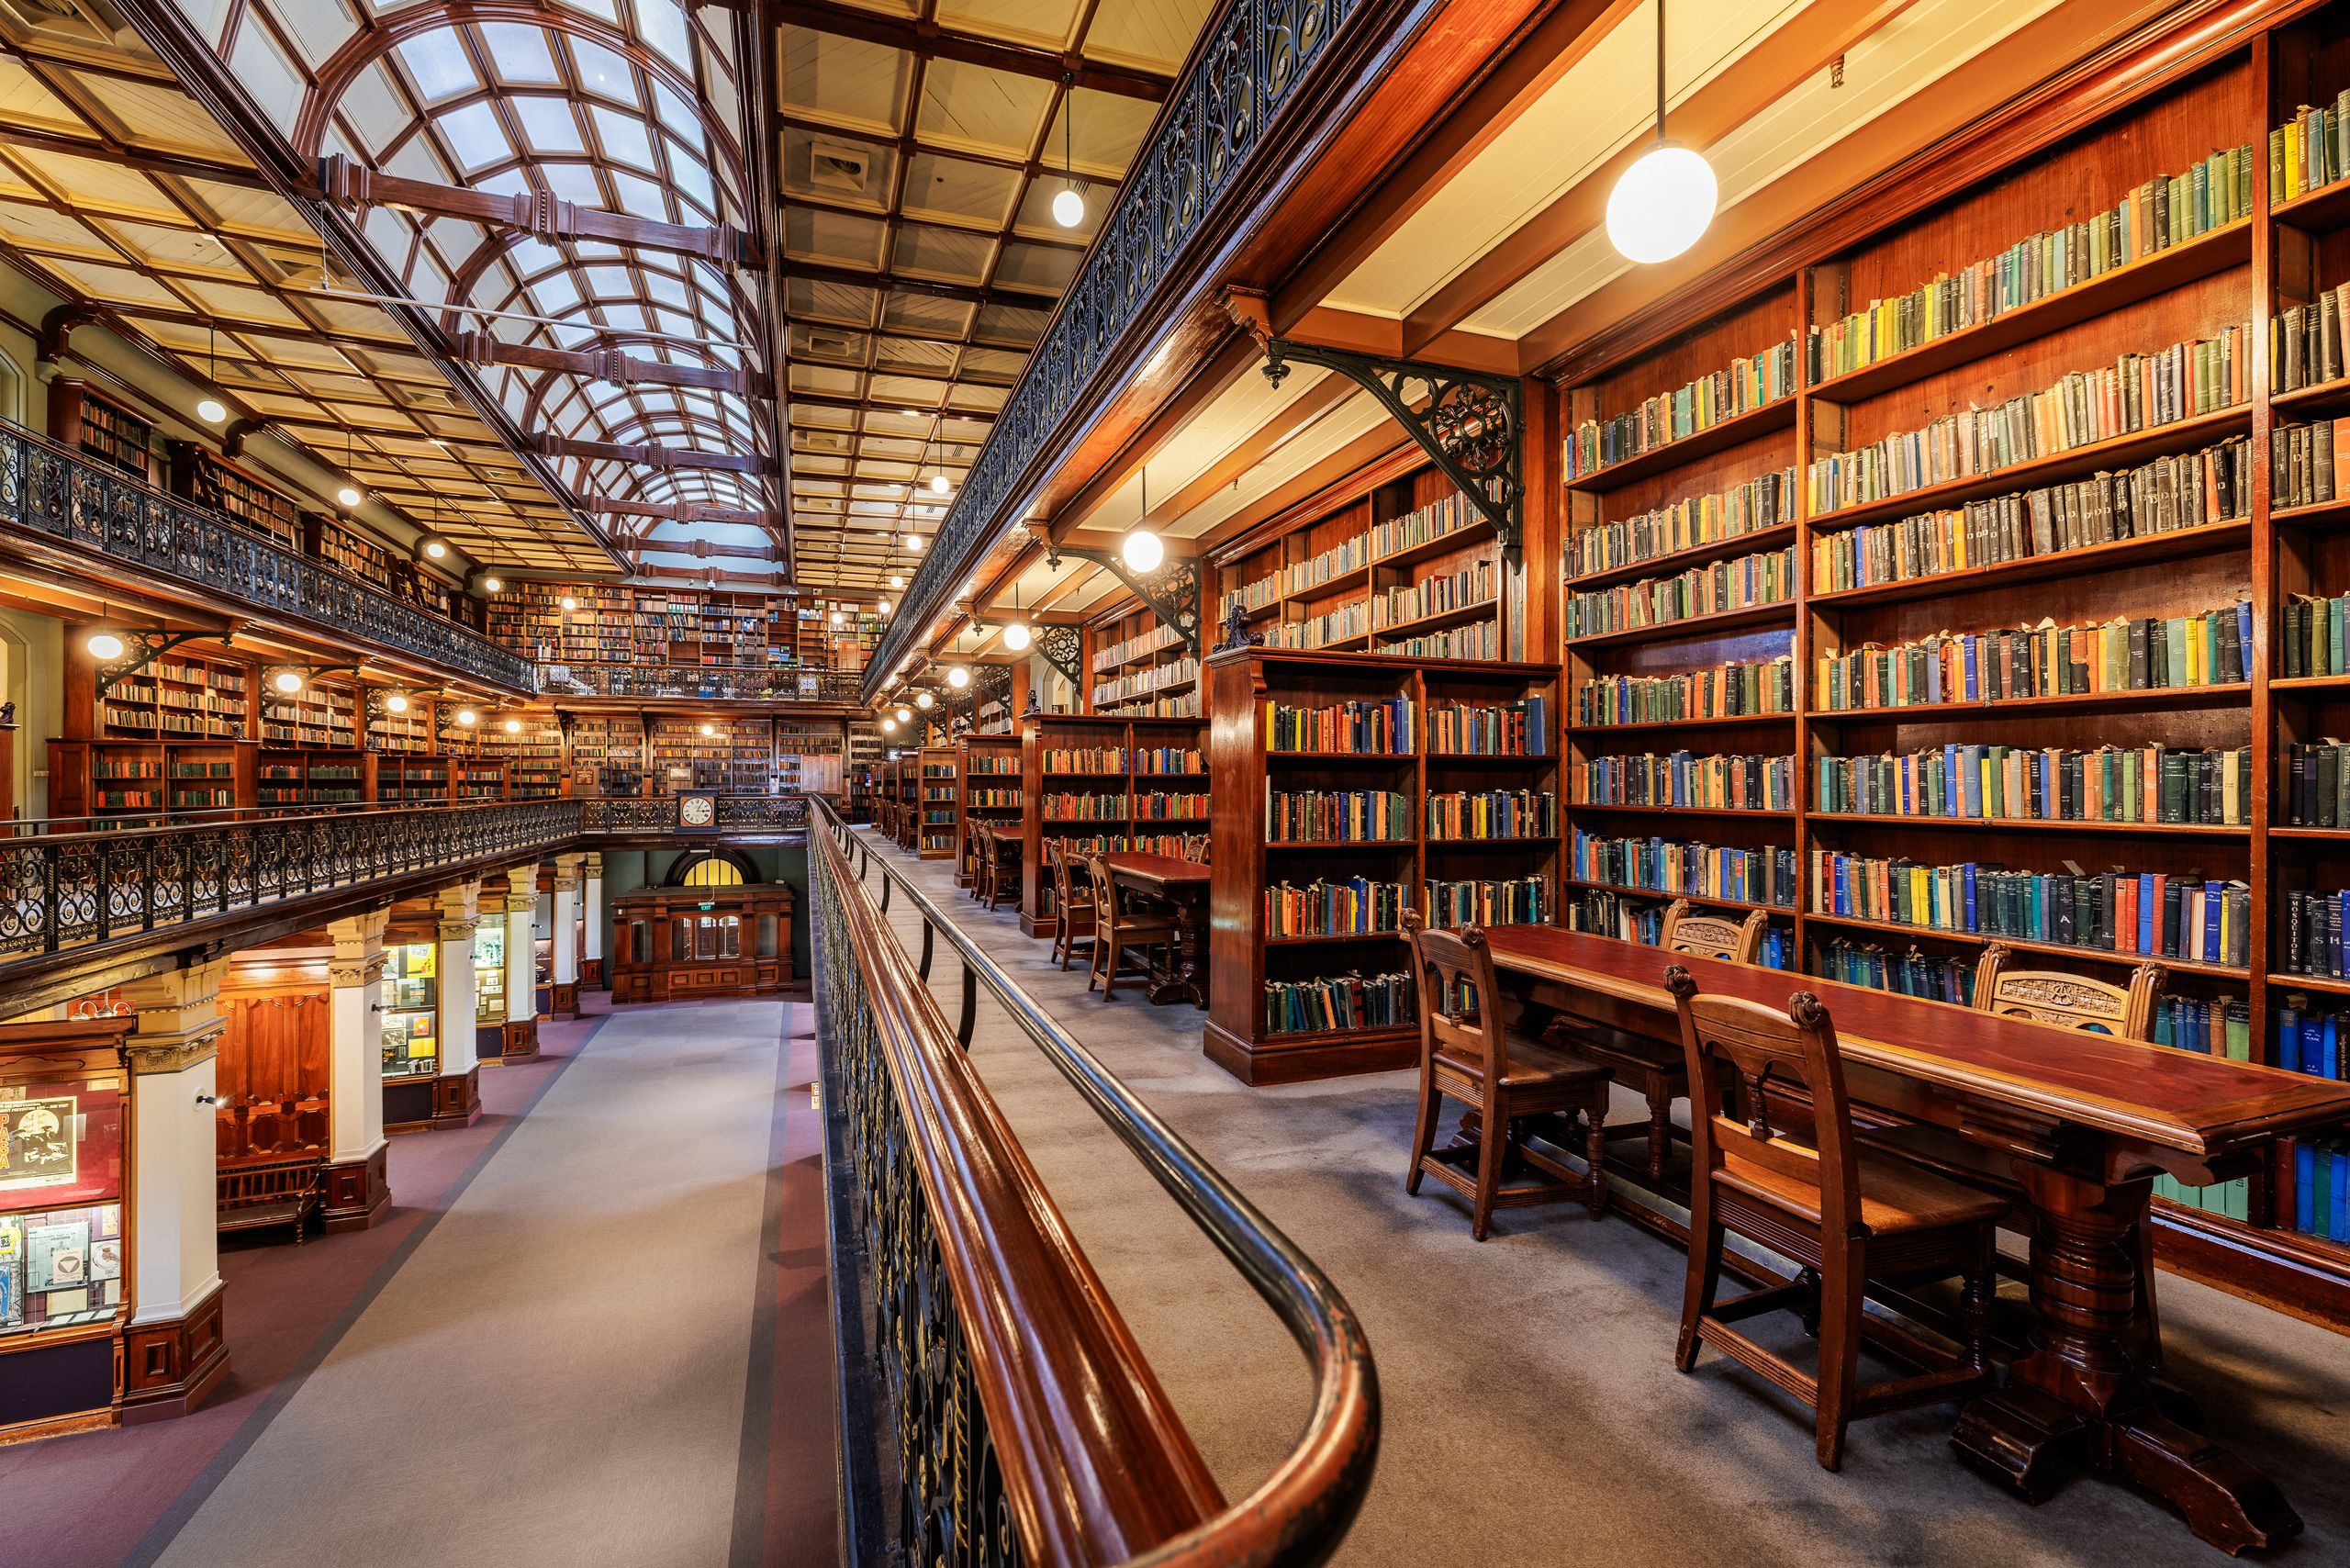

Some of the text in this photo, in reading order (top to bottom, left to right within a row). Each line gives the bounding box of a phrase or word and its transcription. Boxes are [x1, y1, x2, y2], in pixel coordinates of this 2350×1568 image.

[1957, 785, 1964, 793] S
[2060, 914, 2071, 924] A
[2290, 901, 2299, 961] MOSQUITOES
[2314, 936, 2323, 945] S
